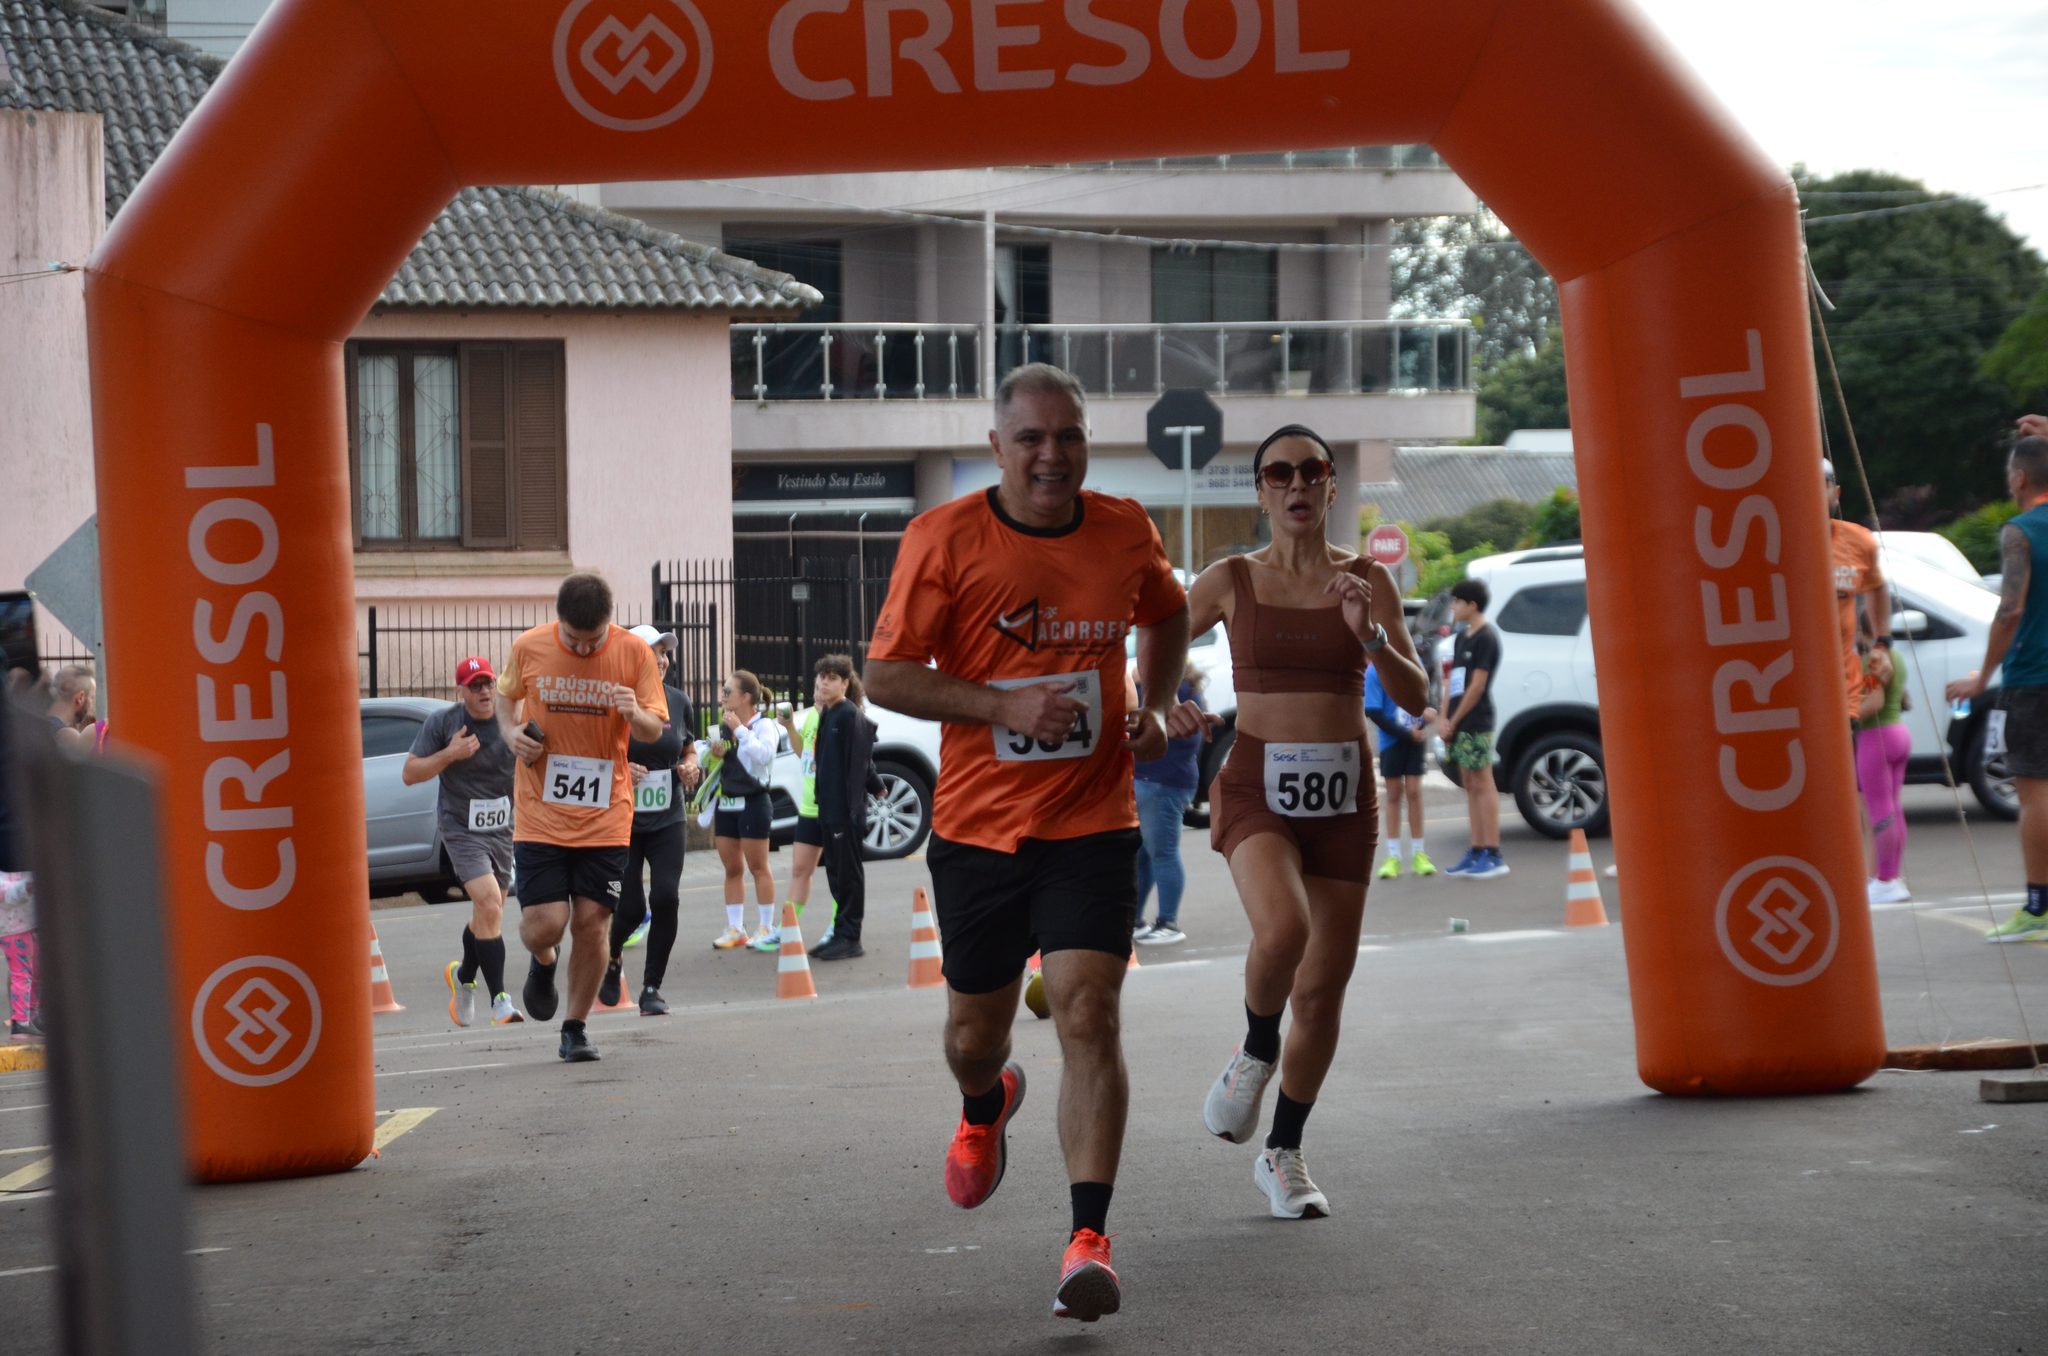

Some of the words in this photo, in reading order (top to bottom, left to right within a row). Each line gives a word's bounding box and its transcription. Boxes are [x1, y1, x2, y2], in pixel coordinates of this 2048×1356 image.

[767, 0, 1350, 100] CRESOL
[777, 473, 826, 488] Vestindo
[829, 472, 850, 487] Seu
[852, 472, 886, 487] Estilo
[1375, 538, 1401, 551] PARE
[1679, 328, 1807, 812] CRESOL
[184, 422, 297, 911] CRESOL
[540, 689, 616, 706] REGIONAL
[553, 774, 601, 803] 541
[1278, 771, 1348, 811] 580
[475, 809, 506, 828] 650
